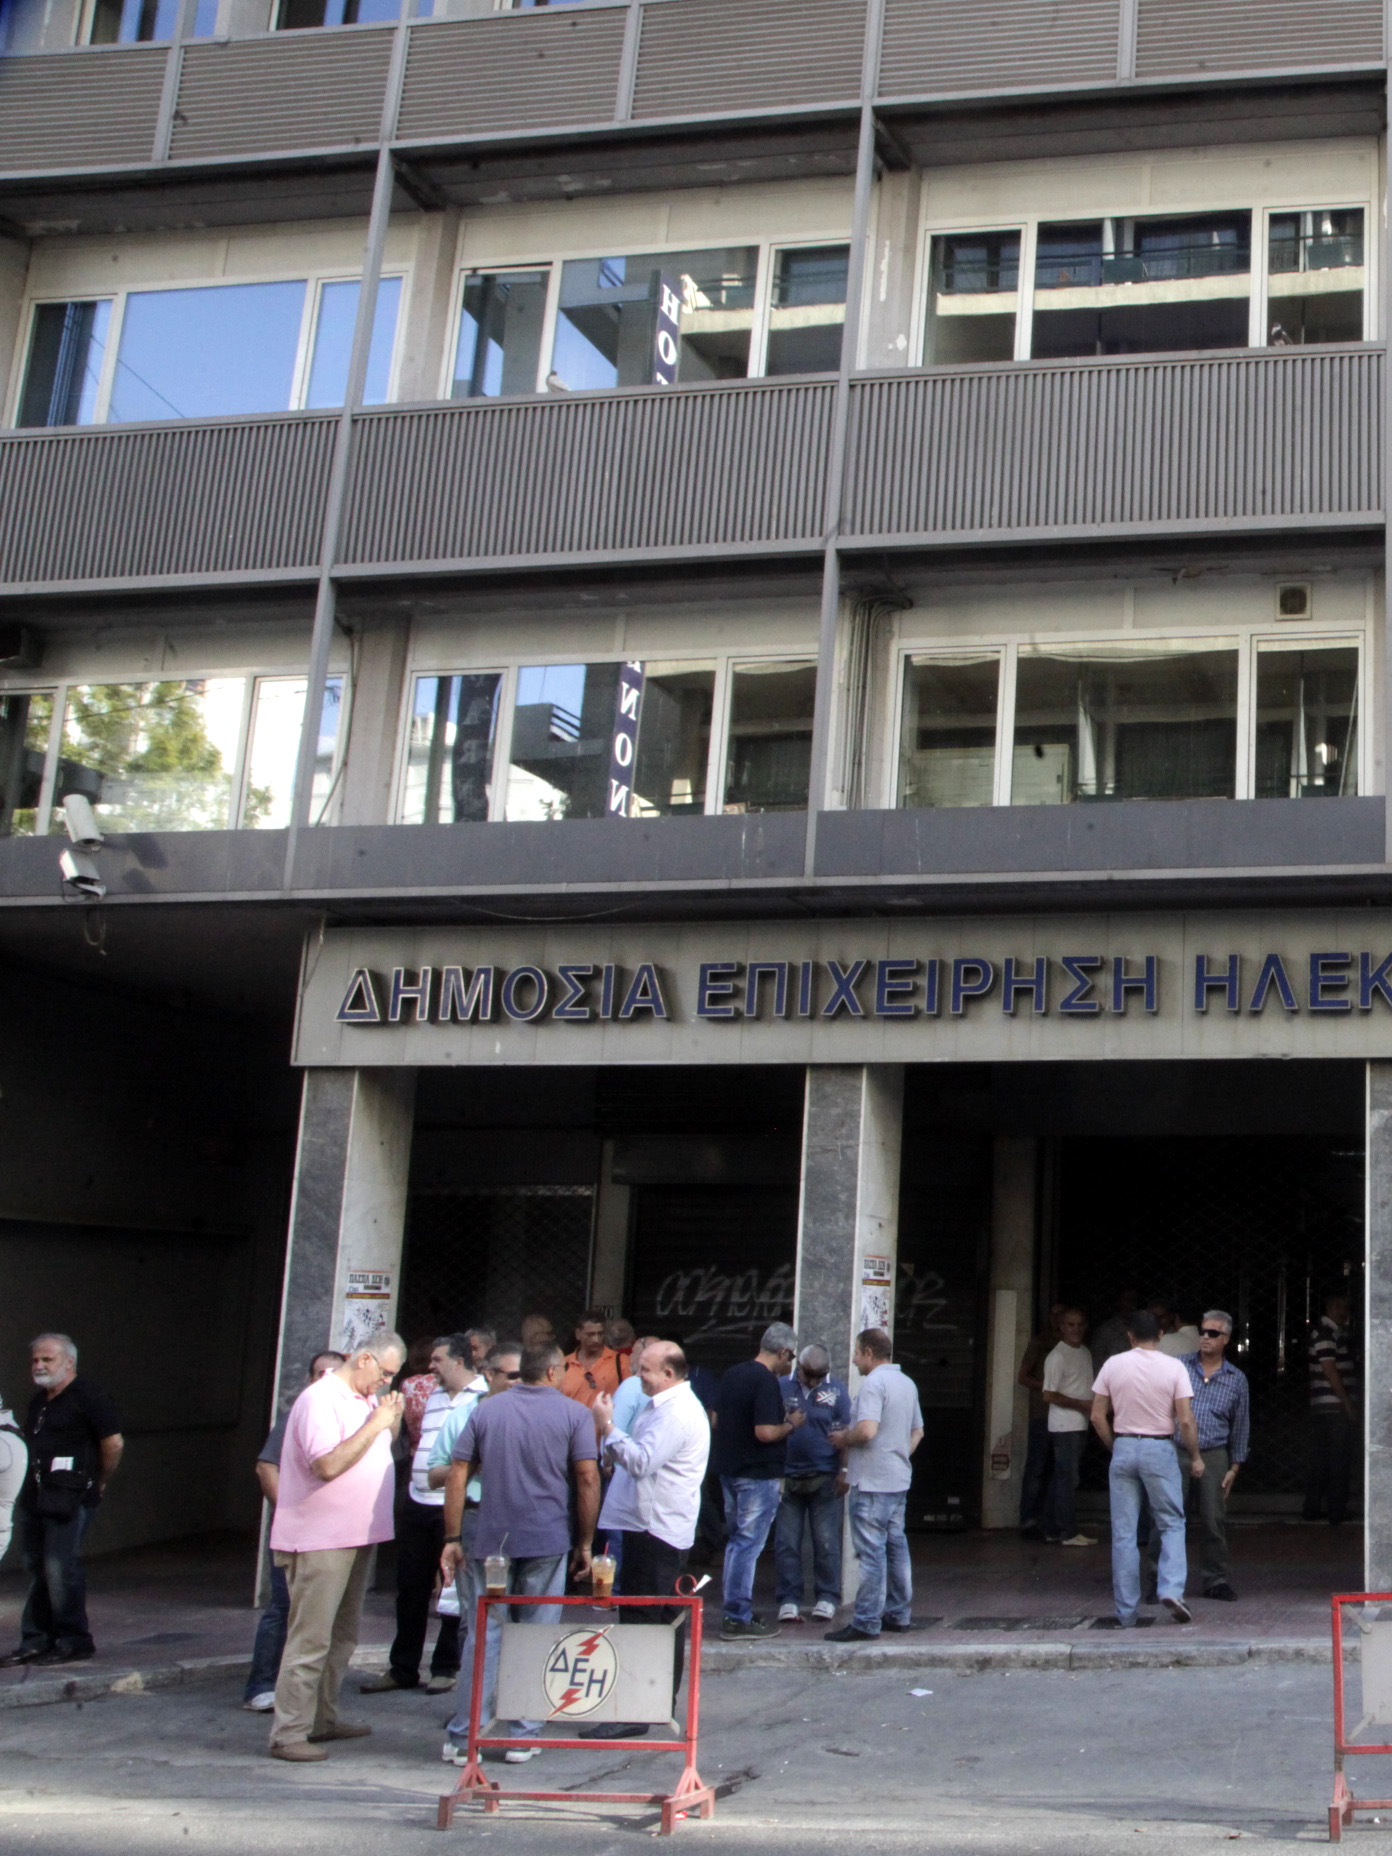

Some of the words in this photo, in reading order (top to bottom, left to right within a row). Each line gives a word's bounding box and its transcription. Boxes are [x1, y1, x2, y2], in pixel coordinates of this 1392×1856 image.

[335, 961, 669, 1024] ΔΗΜΟΣΙΑ
[696, 955, 1159, 1020] ΕΠΙΧΕΙΡΗΣΗ
[548, 1647, 608, 1698] ΔΕΗ
